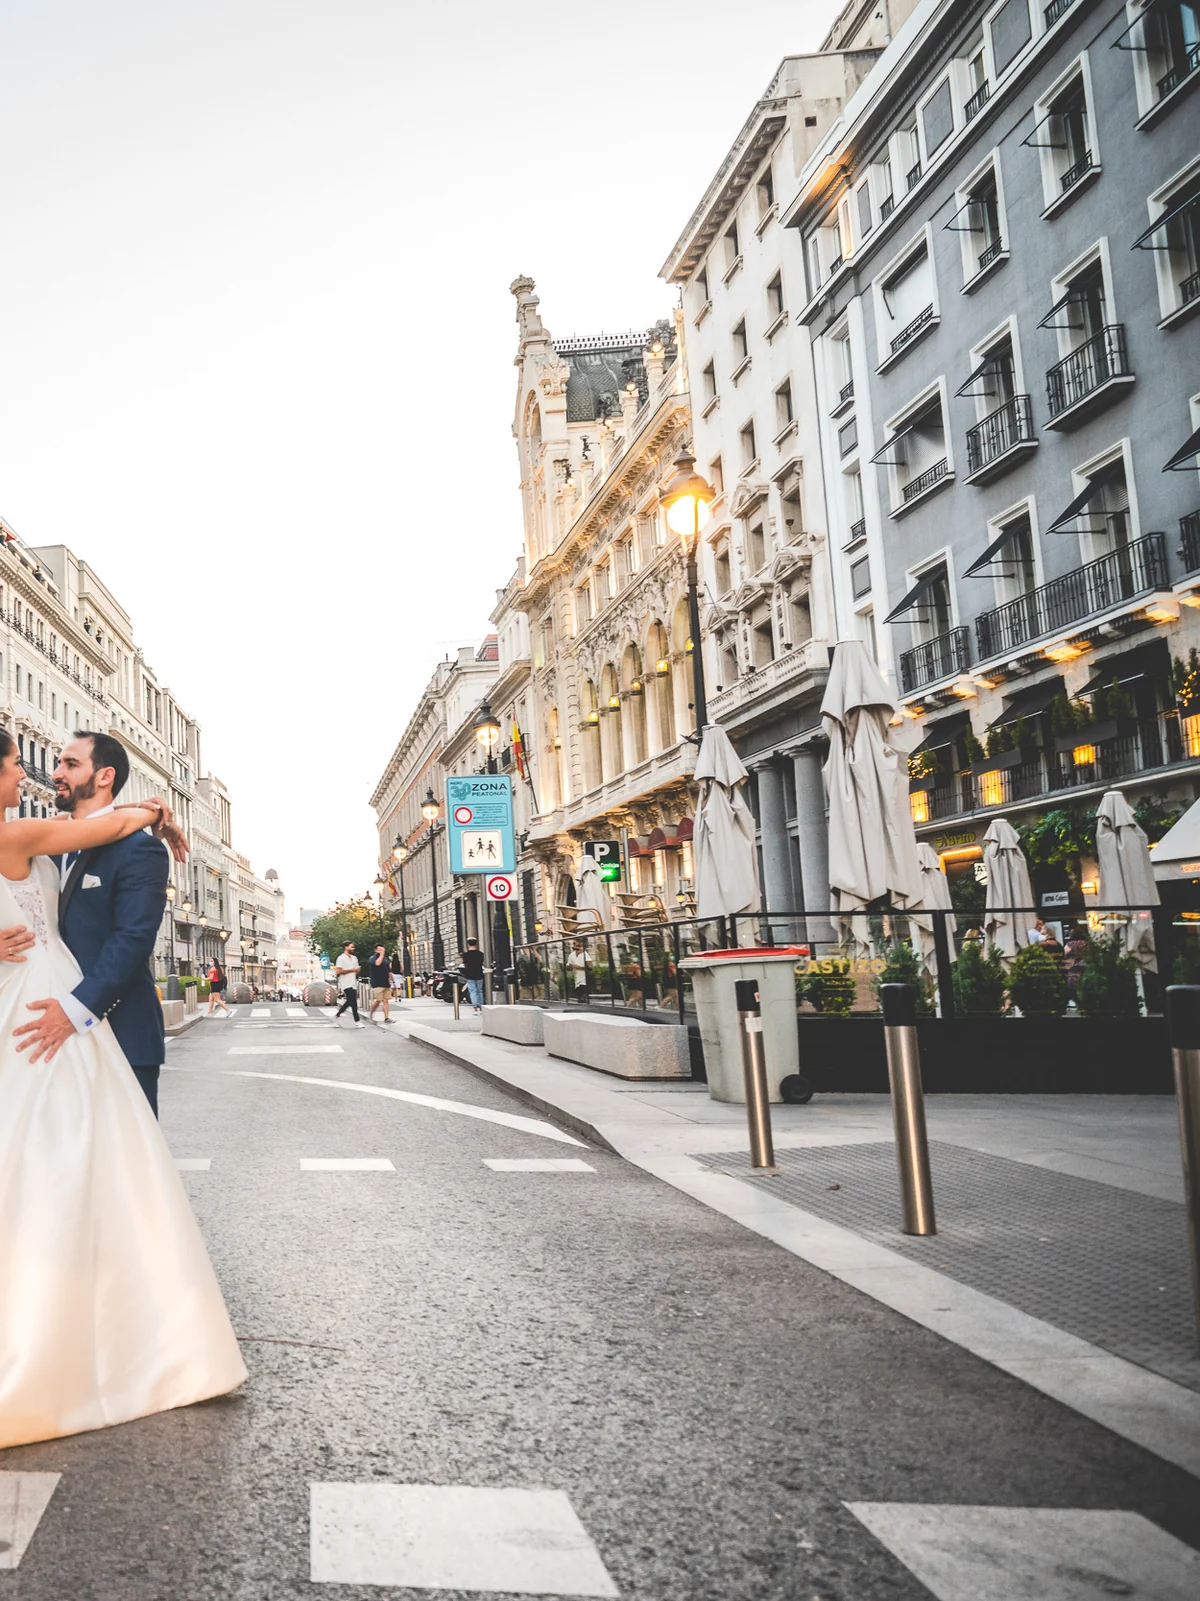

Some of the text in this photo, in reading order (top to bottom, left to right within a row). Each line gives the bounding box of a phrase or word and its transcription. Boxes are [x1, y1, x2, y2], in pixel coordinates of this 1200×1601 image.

[471, 783, 508, 791] ZONA
[593, 843, 611, 862] P
[494, 884, 506, 892] 10
[794, 958, 887, 975] CASTIZO
